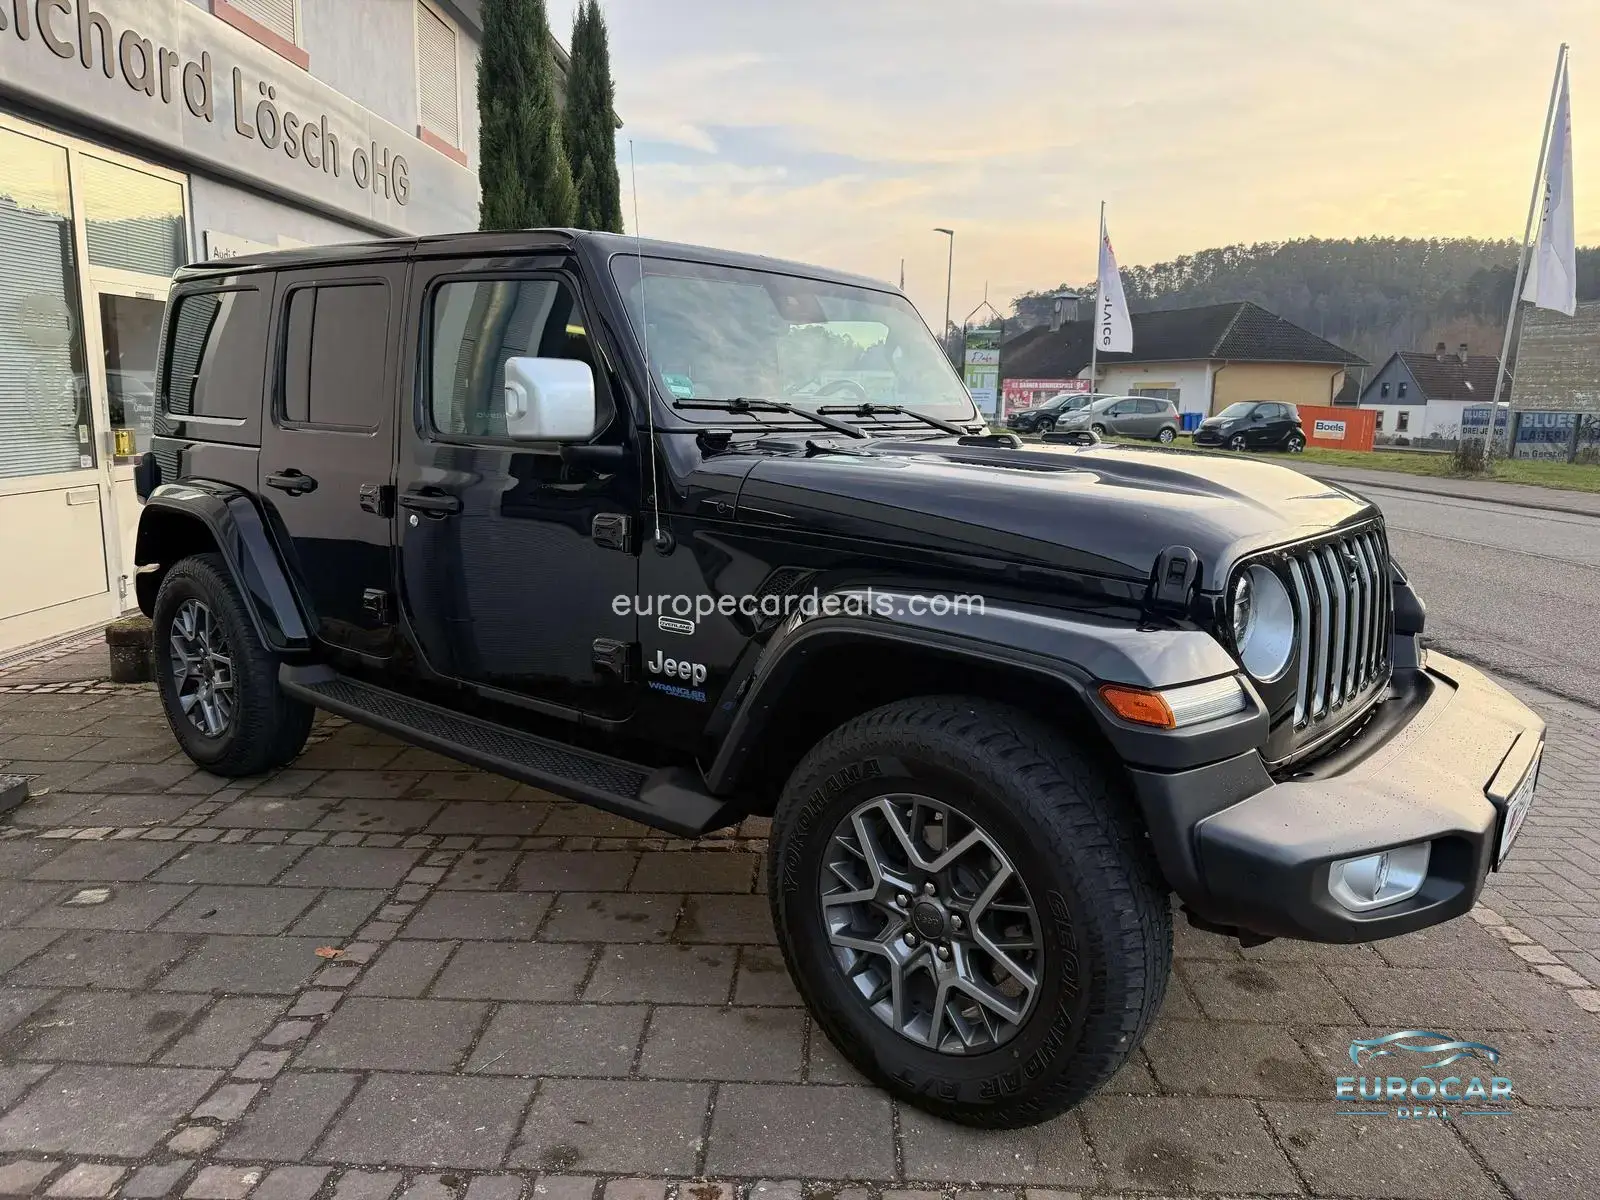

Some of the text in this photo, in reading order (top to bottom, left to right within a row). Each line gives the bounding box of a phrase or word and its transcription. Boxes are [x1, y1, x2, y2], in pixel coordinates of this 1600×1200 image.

[0, 0, 411, 206] ichard Lösch oHG
[213, 246, 231, 259] Audi
[1315, 421, 1344, 432] Boels
[1480, 427, 1504, 436] JENS
[648, 650, 708, 687] Jeep
[648, 681, 707, 699] WRANGLER
[783, 758, 883, 893] YOKOHAMA
